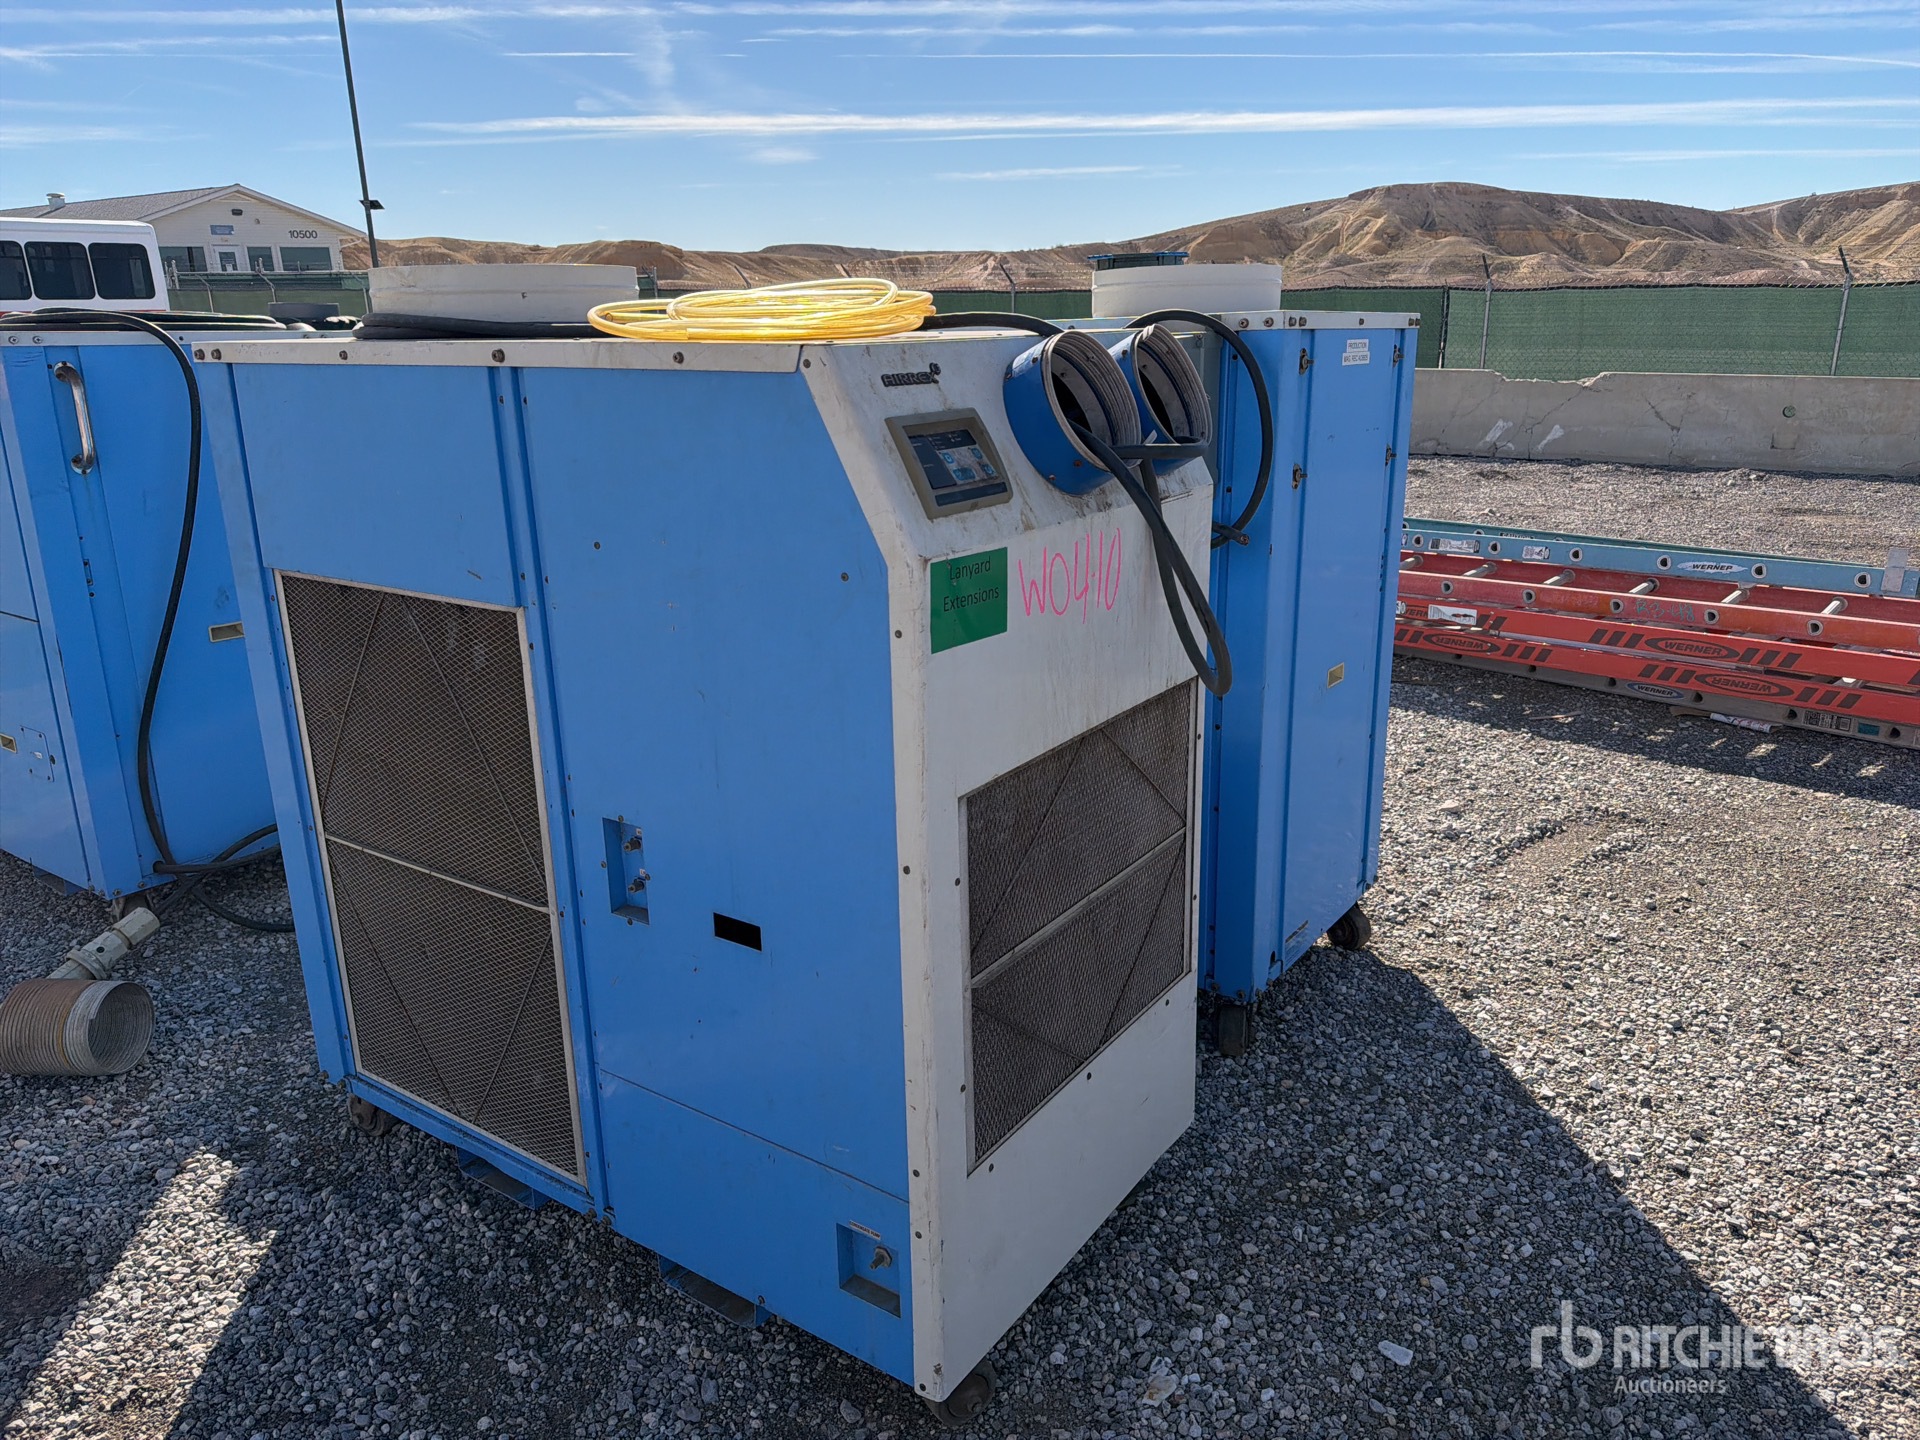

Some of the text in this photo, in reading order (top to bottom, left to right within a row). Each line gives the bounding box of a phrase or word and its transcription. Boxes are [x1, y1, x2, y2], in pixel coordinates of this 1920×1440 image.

[288, 229, 318, 239] 10500
[949, 556, 991, 579] Lanyard
[943, 587, 999, 612] Extensions
[1436, 636, 1484, 650] WERNER
[1664, 641, 1722, 655] WERNER
[1637, 685, 1674, 696] WERNER
[1712, 676, 1773, 692] WERNER
